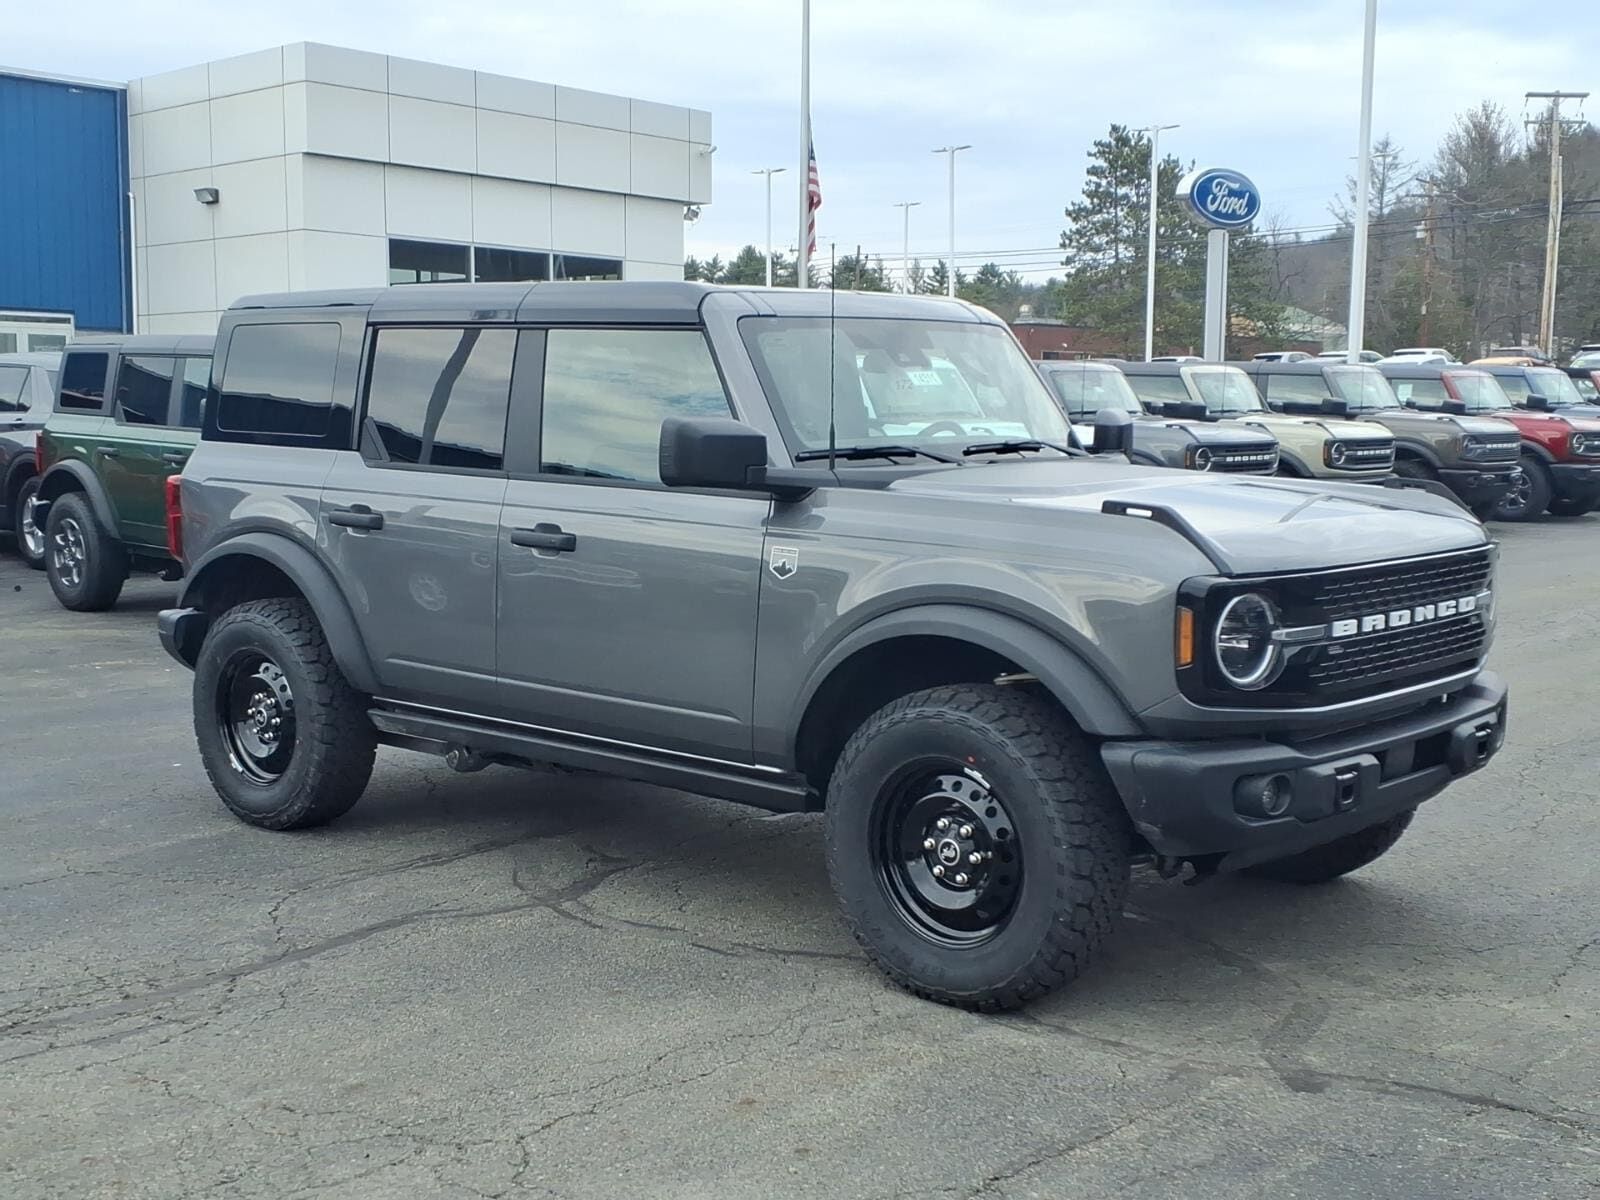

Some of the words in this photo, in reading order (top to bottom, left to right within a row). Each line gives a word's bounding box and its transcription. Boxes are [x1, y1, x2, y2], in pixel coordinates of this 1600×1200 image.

[1206, 177, 1250, 216] Ford
[1225, 454, 1270, 462] BRONCO
[1332, 596, 1476, 637] BRONCO
